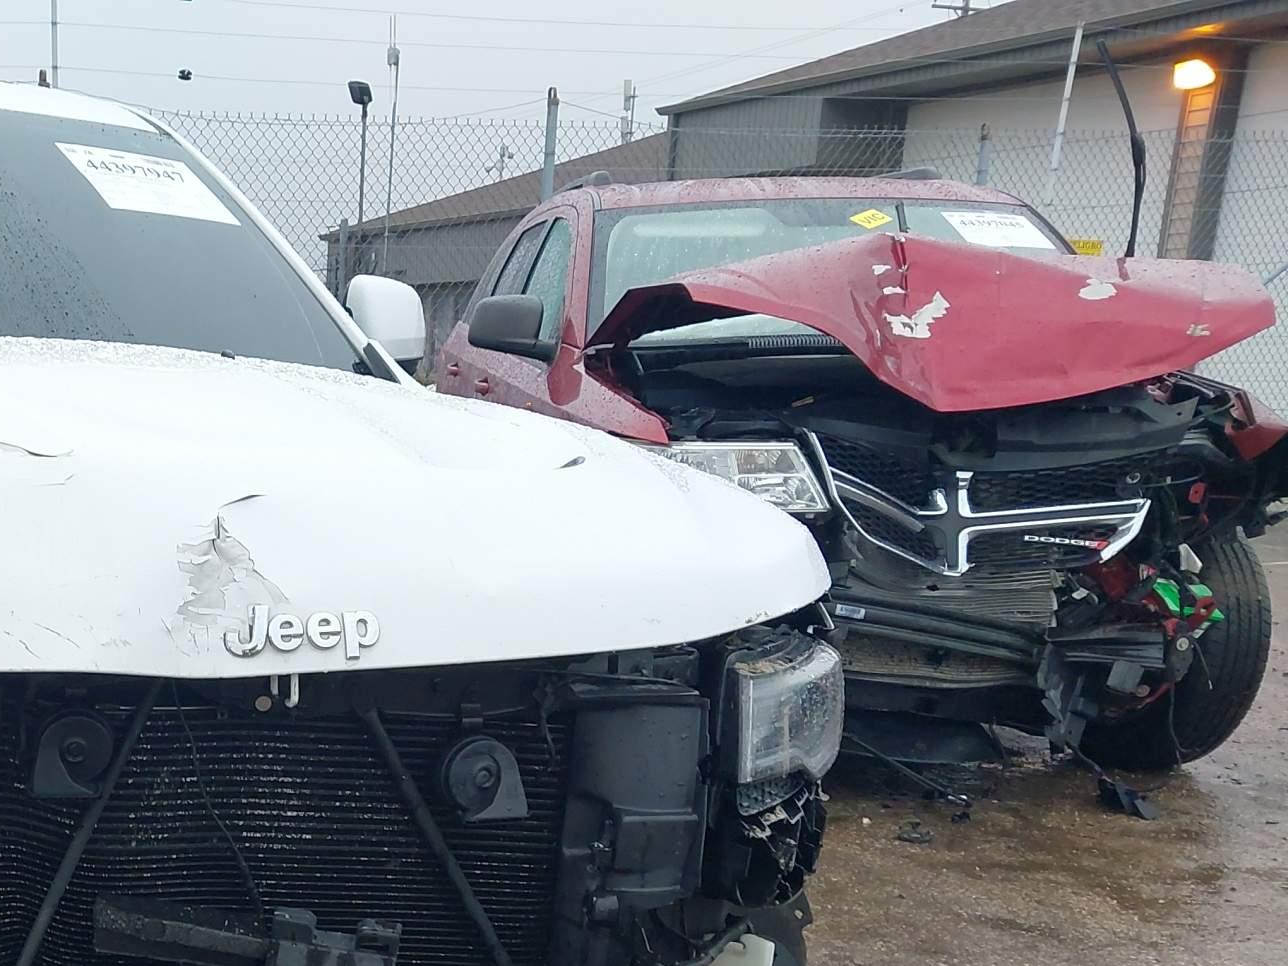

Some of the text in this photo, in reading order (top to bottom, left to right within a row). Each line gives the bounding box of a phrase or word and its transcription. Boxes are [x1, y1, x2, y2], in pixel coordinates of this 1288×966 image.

[85, 159, 185, 183] 44397947
[1024, 534, 1098, 549] DODGE
[223, 603, 382, 661] Jeep
